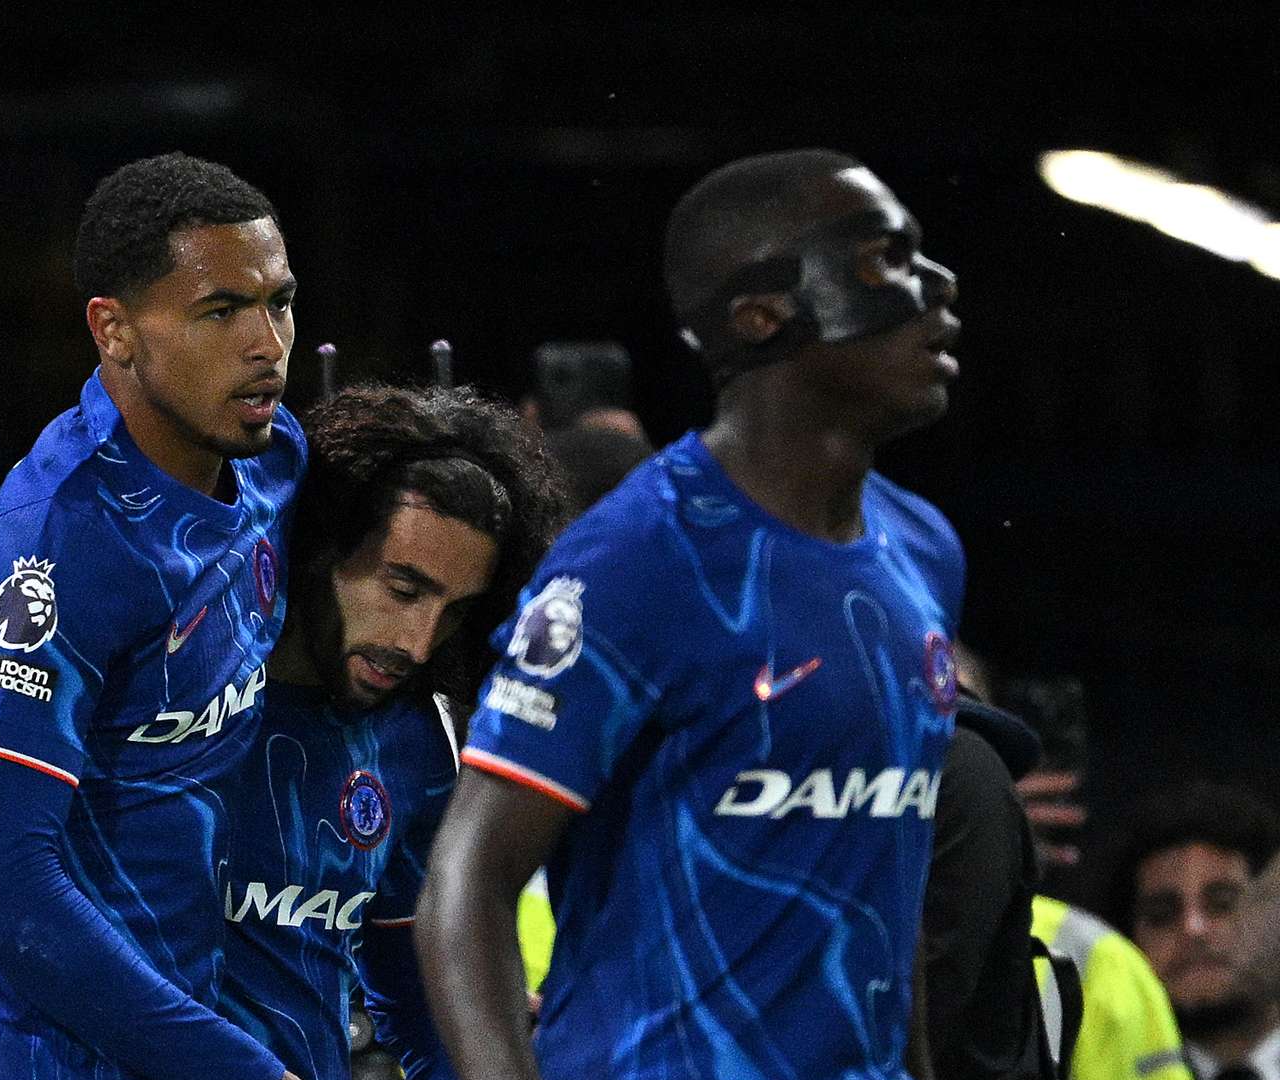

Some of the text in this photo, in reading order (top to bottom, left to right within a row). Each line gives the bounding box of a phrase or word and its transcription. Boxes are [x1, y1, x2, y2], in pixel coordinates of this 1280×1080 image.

[0, 659, 49, 686] room
[713, 767, 943, 819] DAMA
[224, 881, 377, 930] MAC
